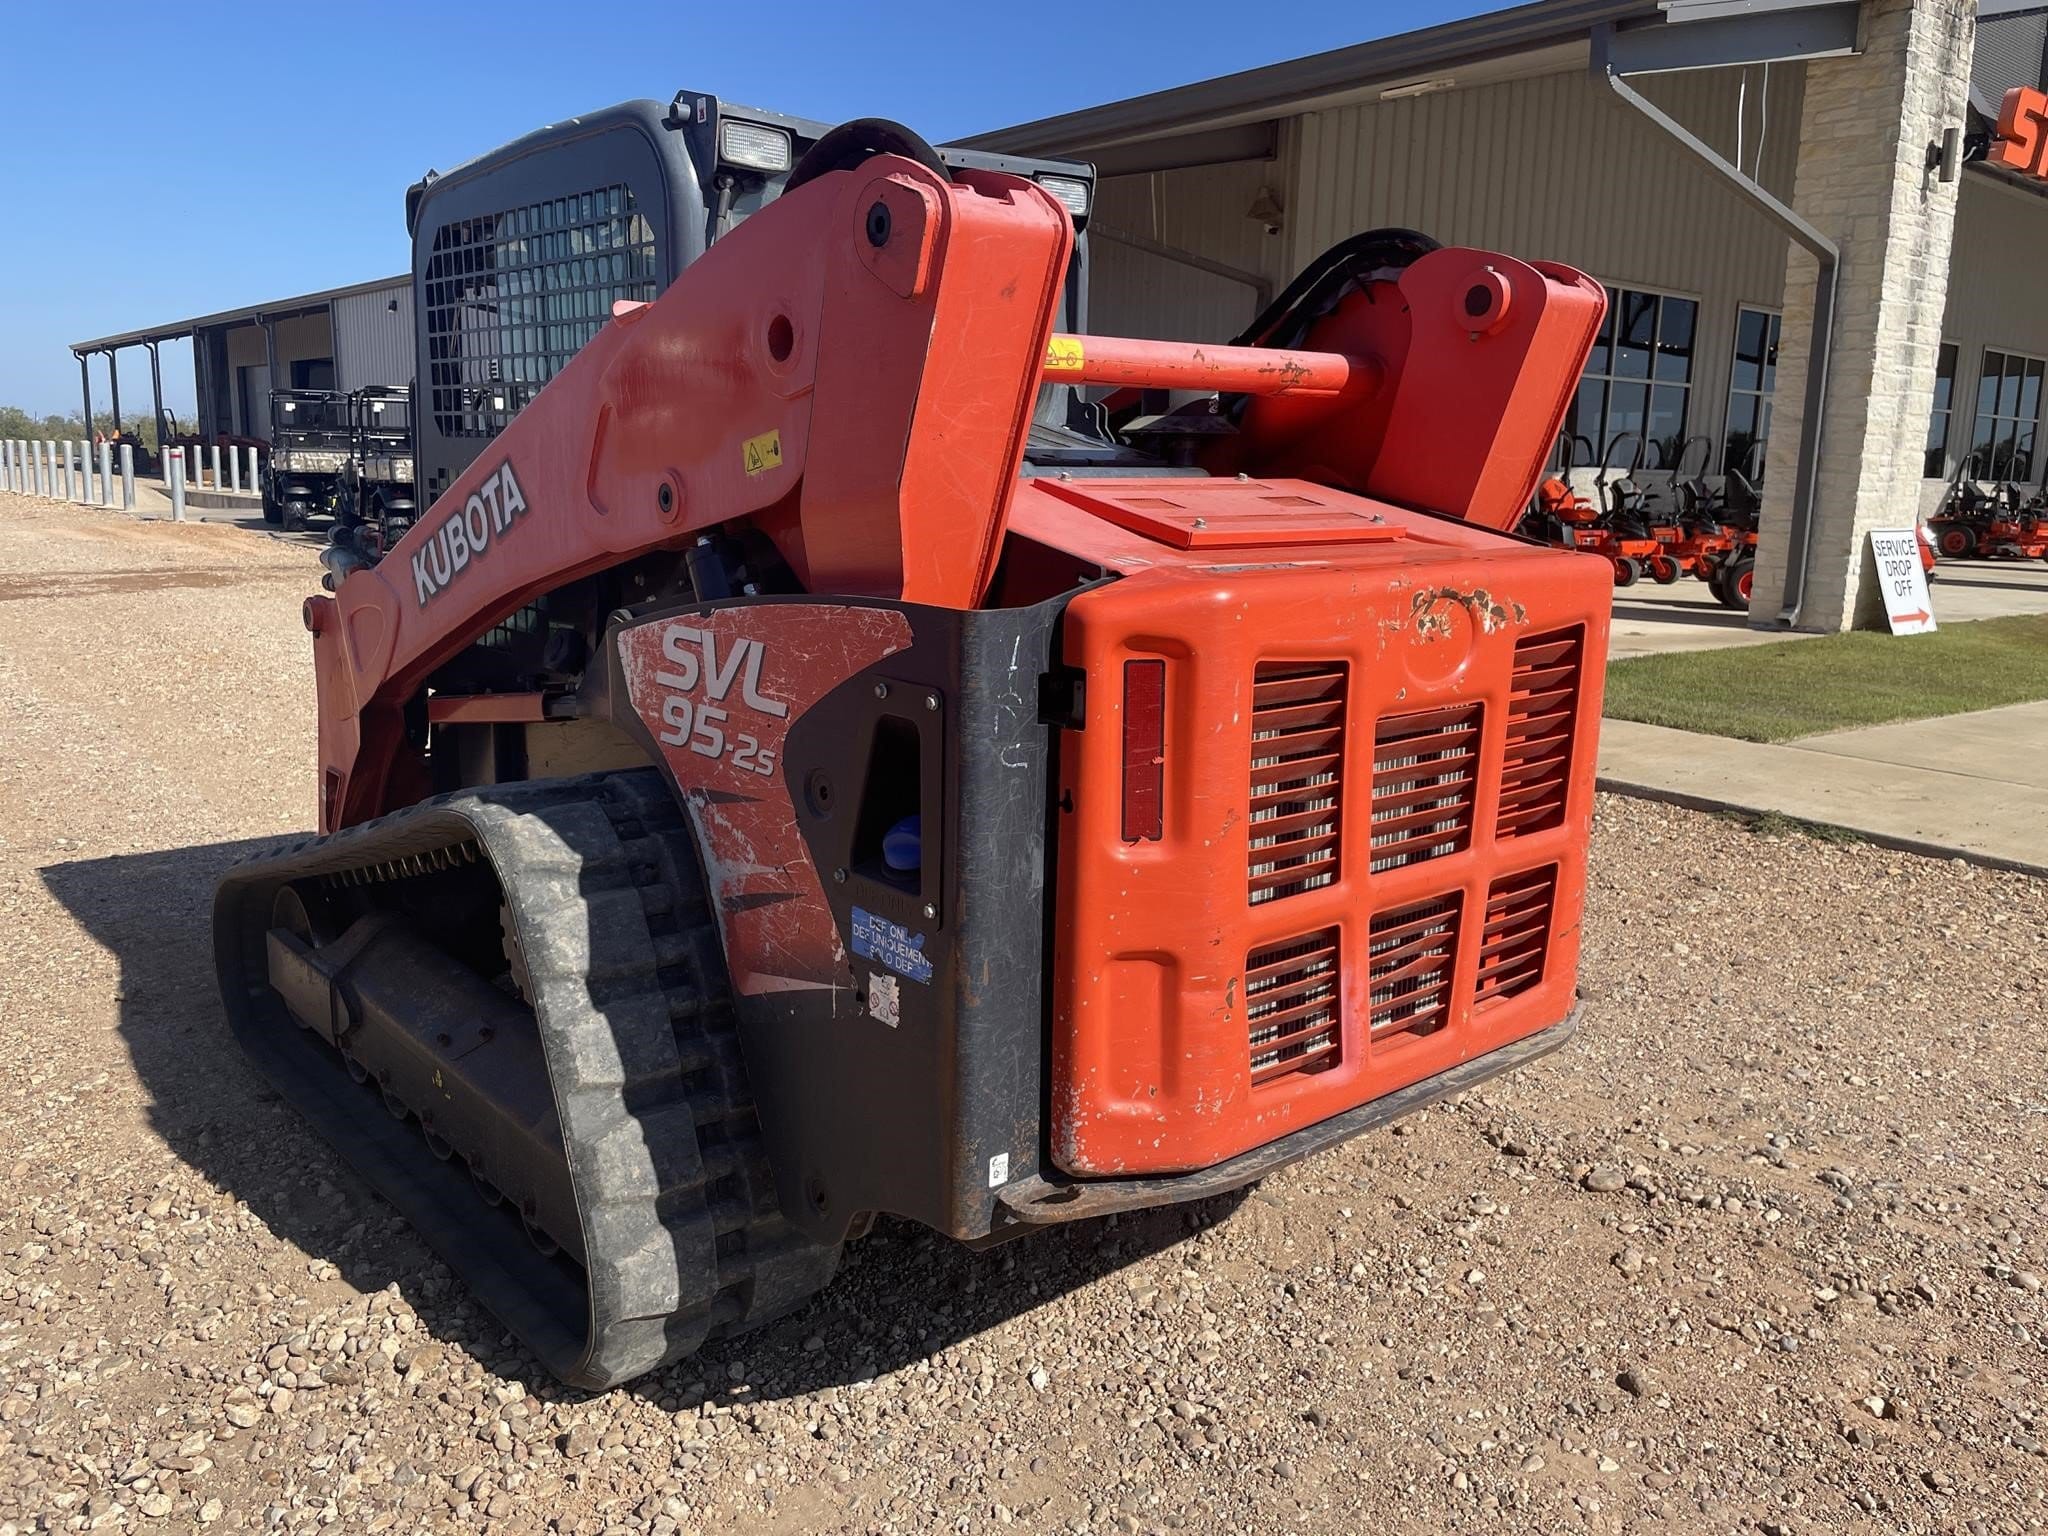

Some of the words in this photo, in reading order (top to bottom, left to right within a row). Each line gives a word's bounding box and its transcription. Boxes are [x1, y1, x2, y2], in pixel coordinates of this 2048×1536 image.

[1999, 86, 2048, 178] S
[411, 462, 526, 605] KUBOTA
[1874, 539, 1917, 557] SERVICE
[1885, 559, 1912, 577] DROP
[1894, 579, 1913, 597] OFF
[656, 624, 789, 718] SVL
[853, 923, 870, 941] DEF
[869, 916, 886, 932] DEF
[895, 957, 913, 973] DEF
